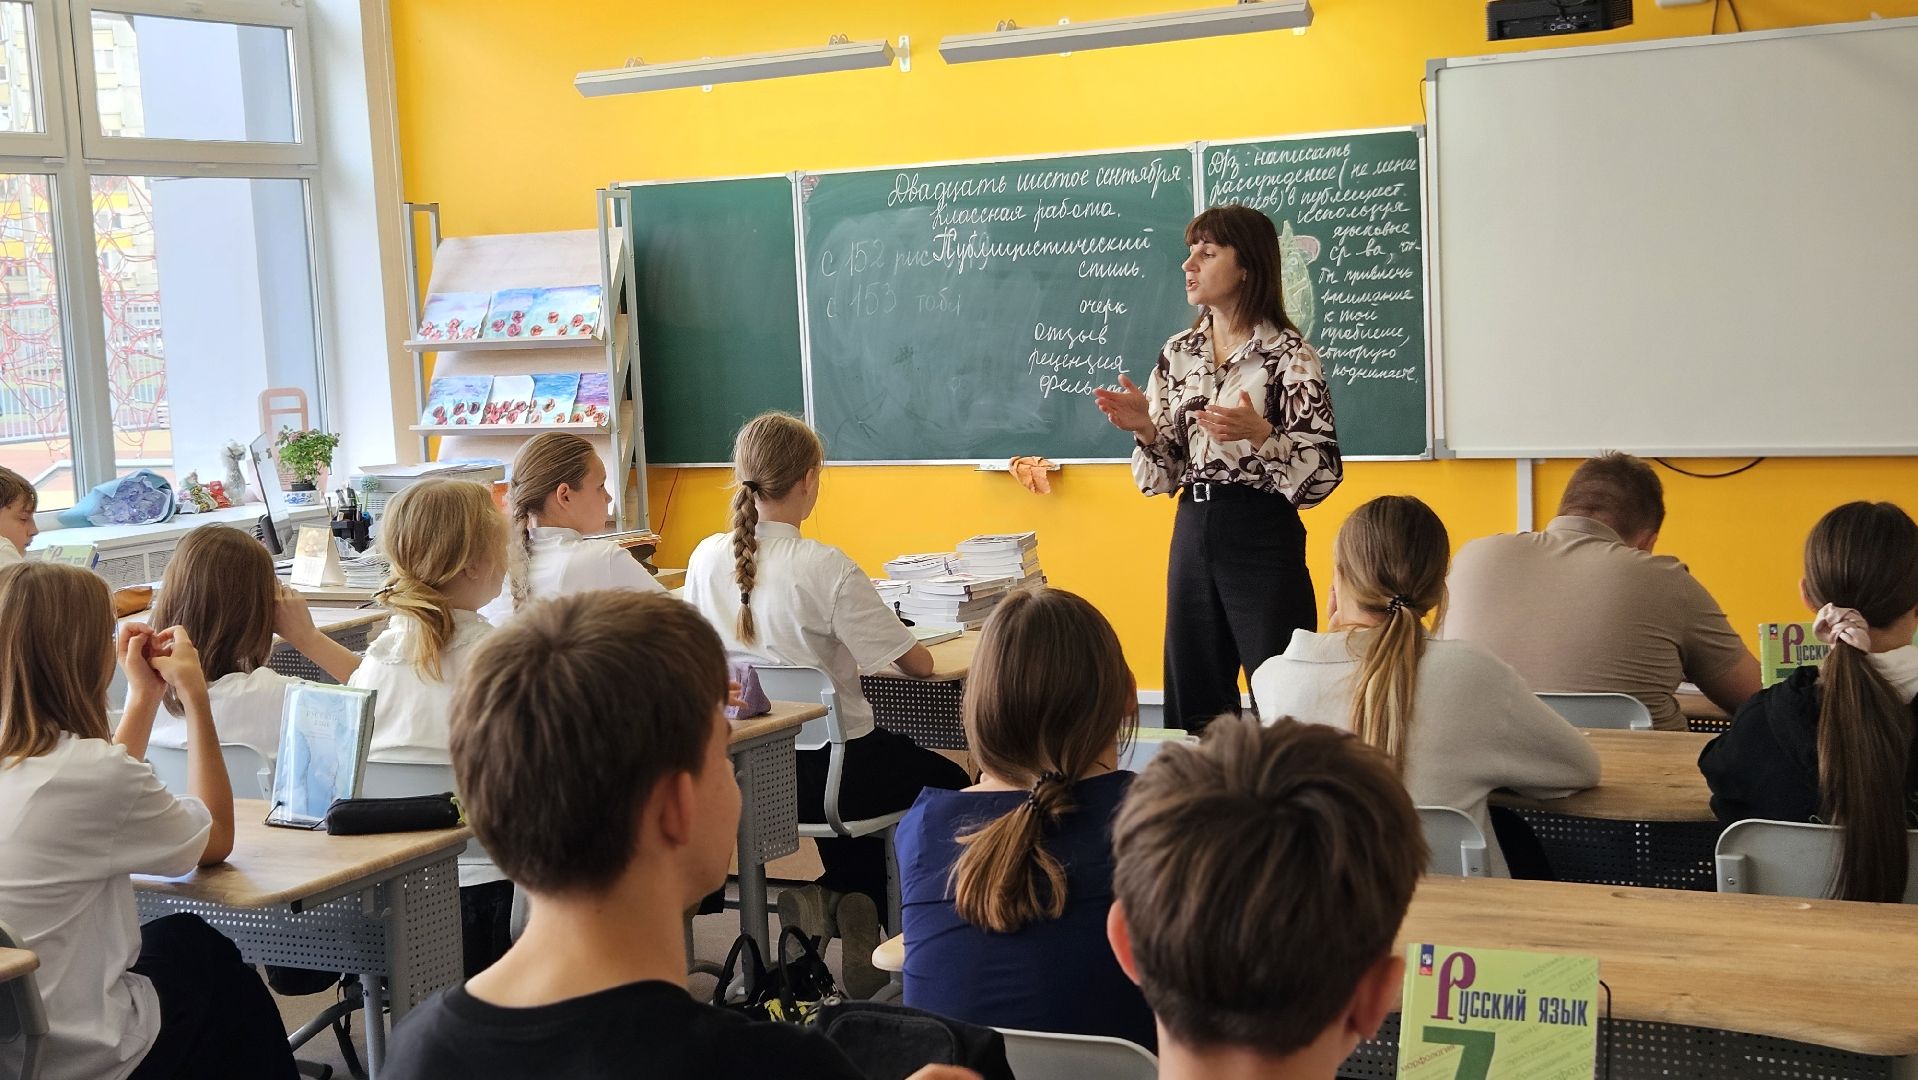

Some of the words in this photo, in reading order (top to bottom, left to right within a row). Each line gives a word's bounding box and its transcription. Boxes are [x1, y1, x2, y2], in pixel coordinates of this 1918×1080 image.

[1254, 143, 1351, 166] написать
[887, 173, 1007, 207] Двадцать
[1080, 298, 1127, 324] очерк
[1430, 951, 1527, 1025] Русский
[1538, 996, 1589, 1028] язык
